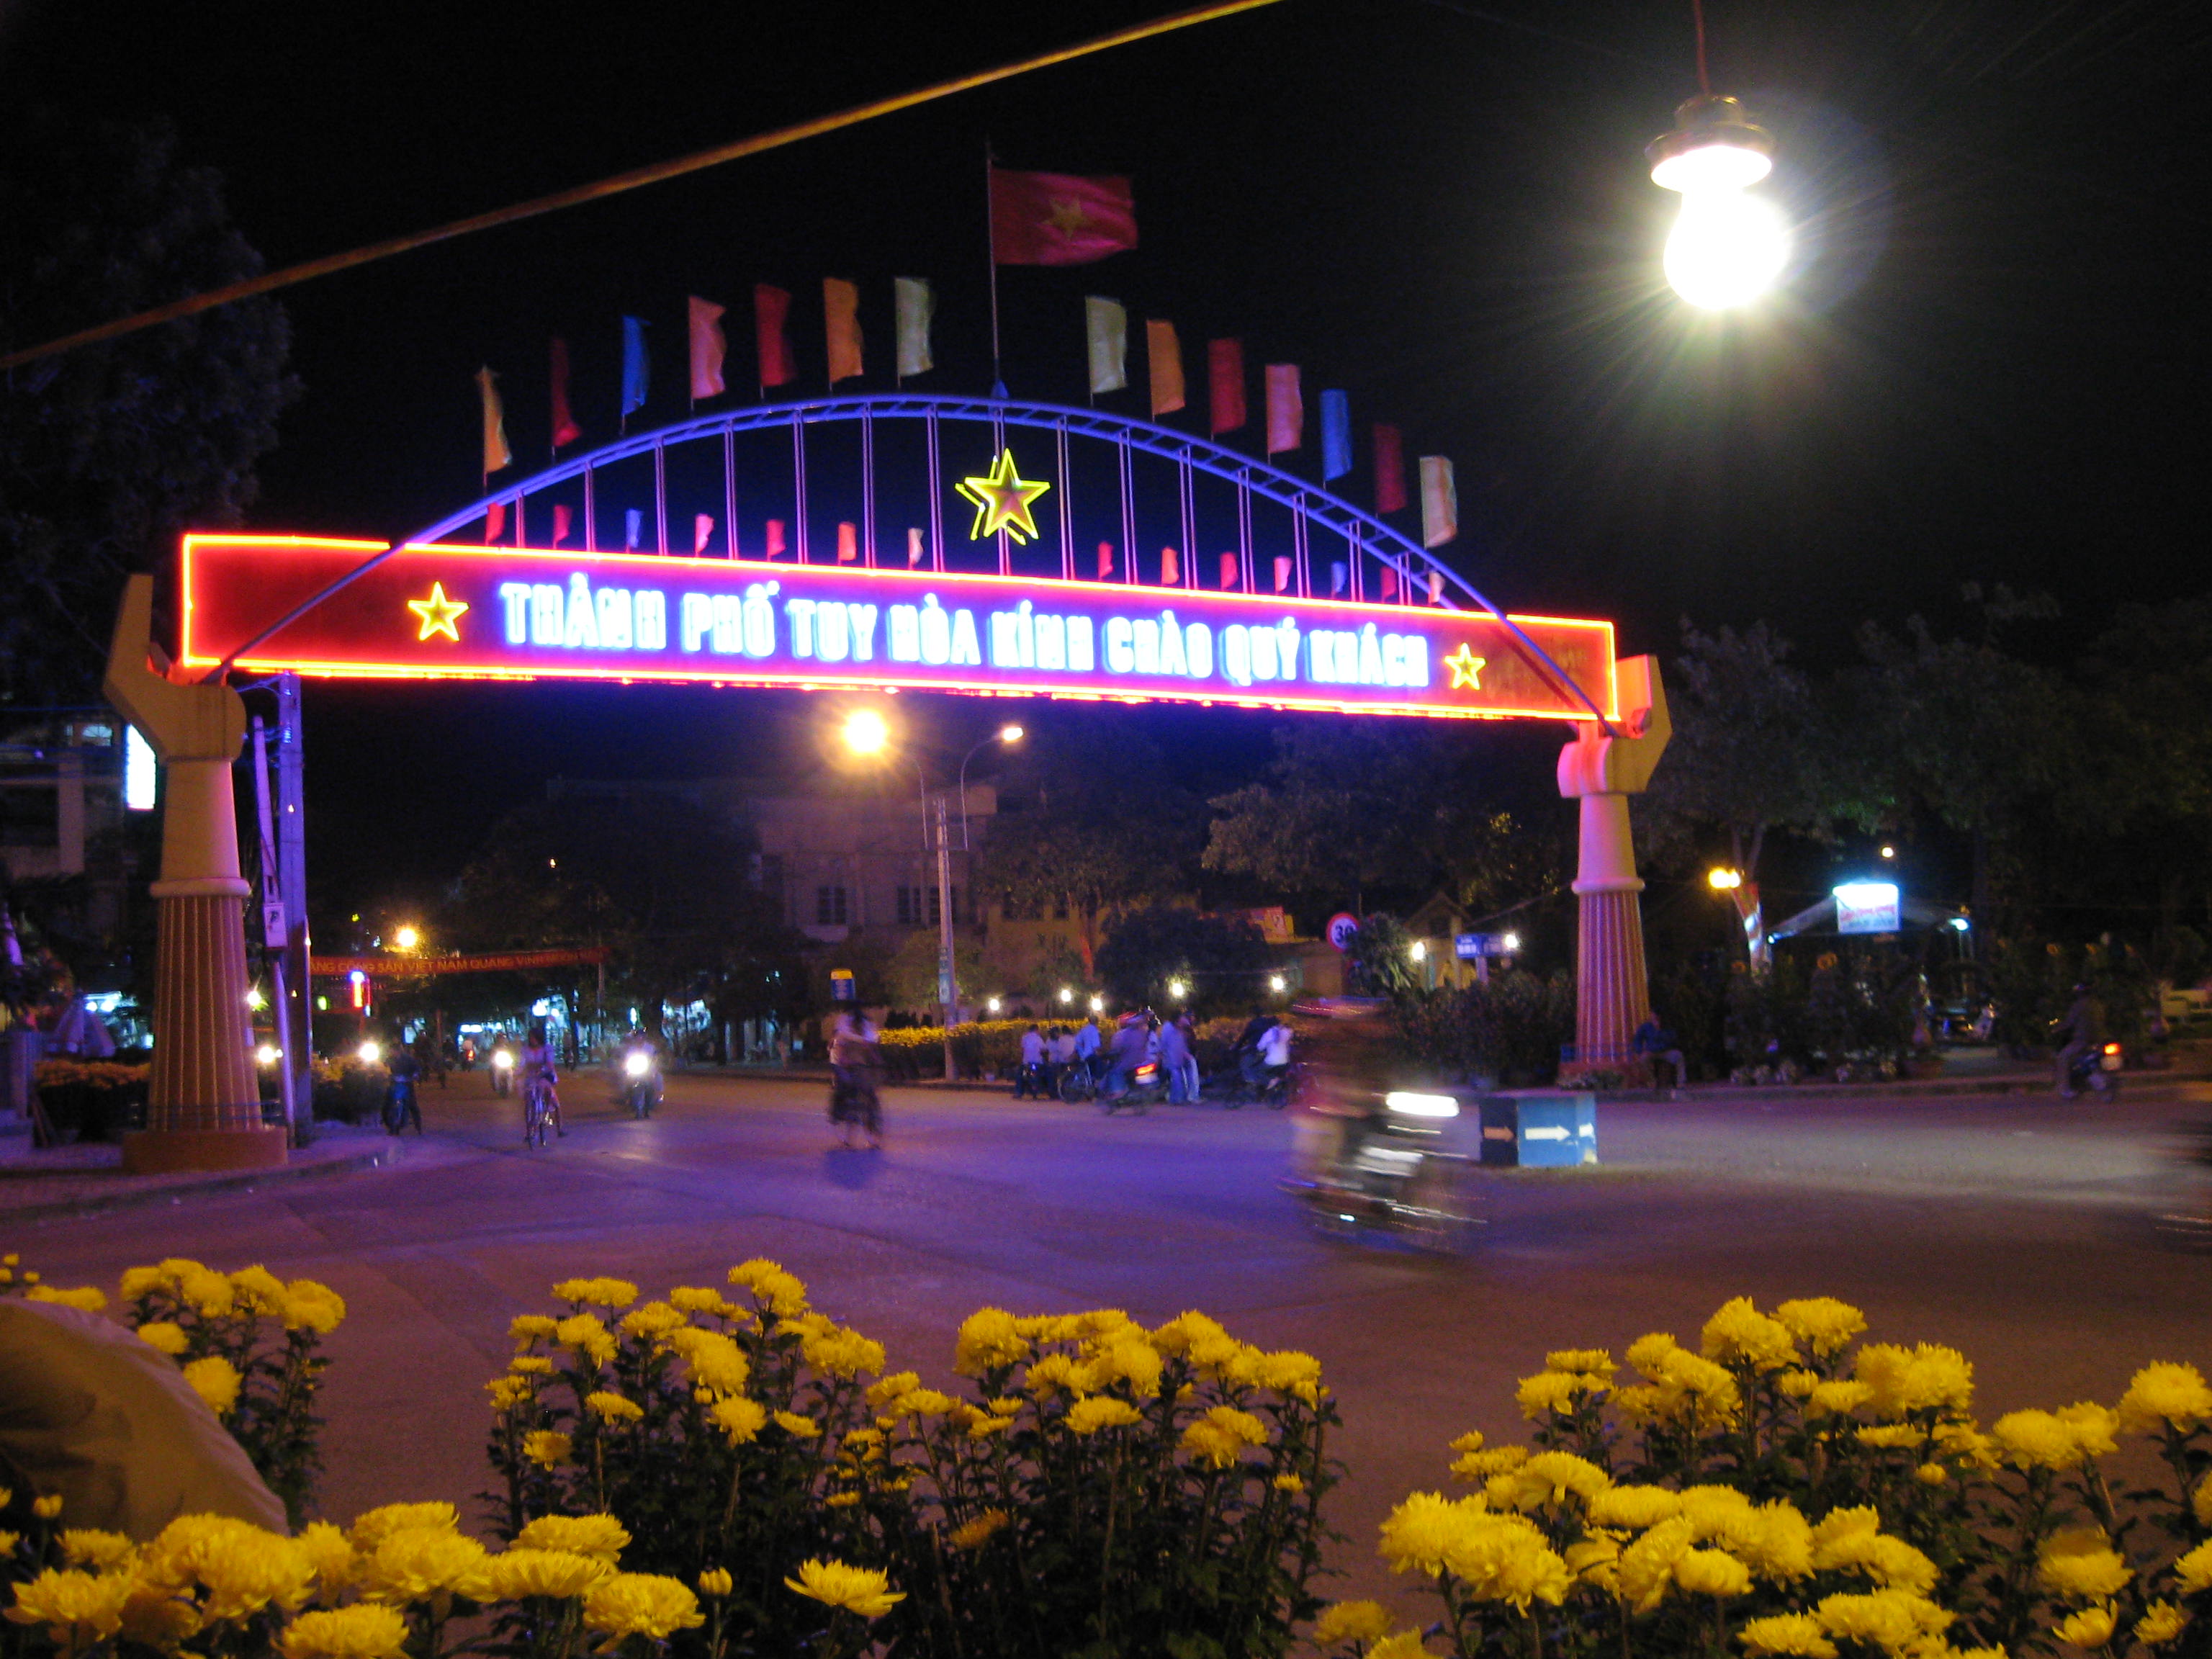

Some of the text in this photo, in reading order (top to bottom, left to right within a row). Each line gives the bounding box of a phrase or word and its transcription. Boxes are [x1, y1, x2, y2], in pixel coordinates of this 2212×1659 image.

[785, 598, 878, 662] TUY
[987, 599, 1094, 671] KÍNH
[1102, 610, 1213, 678] CHÀO
[1220, 616, 1300, 686] QUÝ
[1305, 622, 1429, 687] KHÁCH
